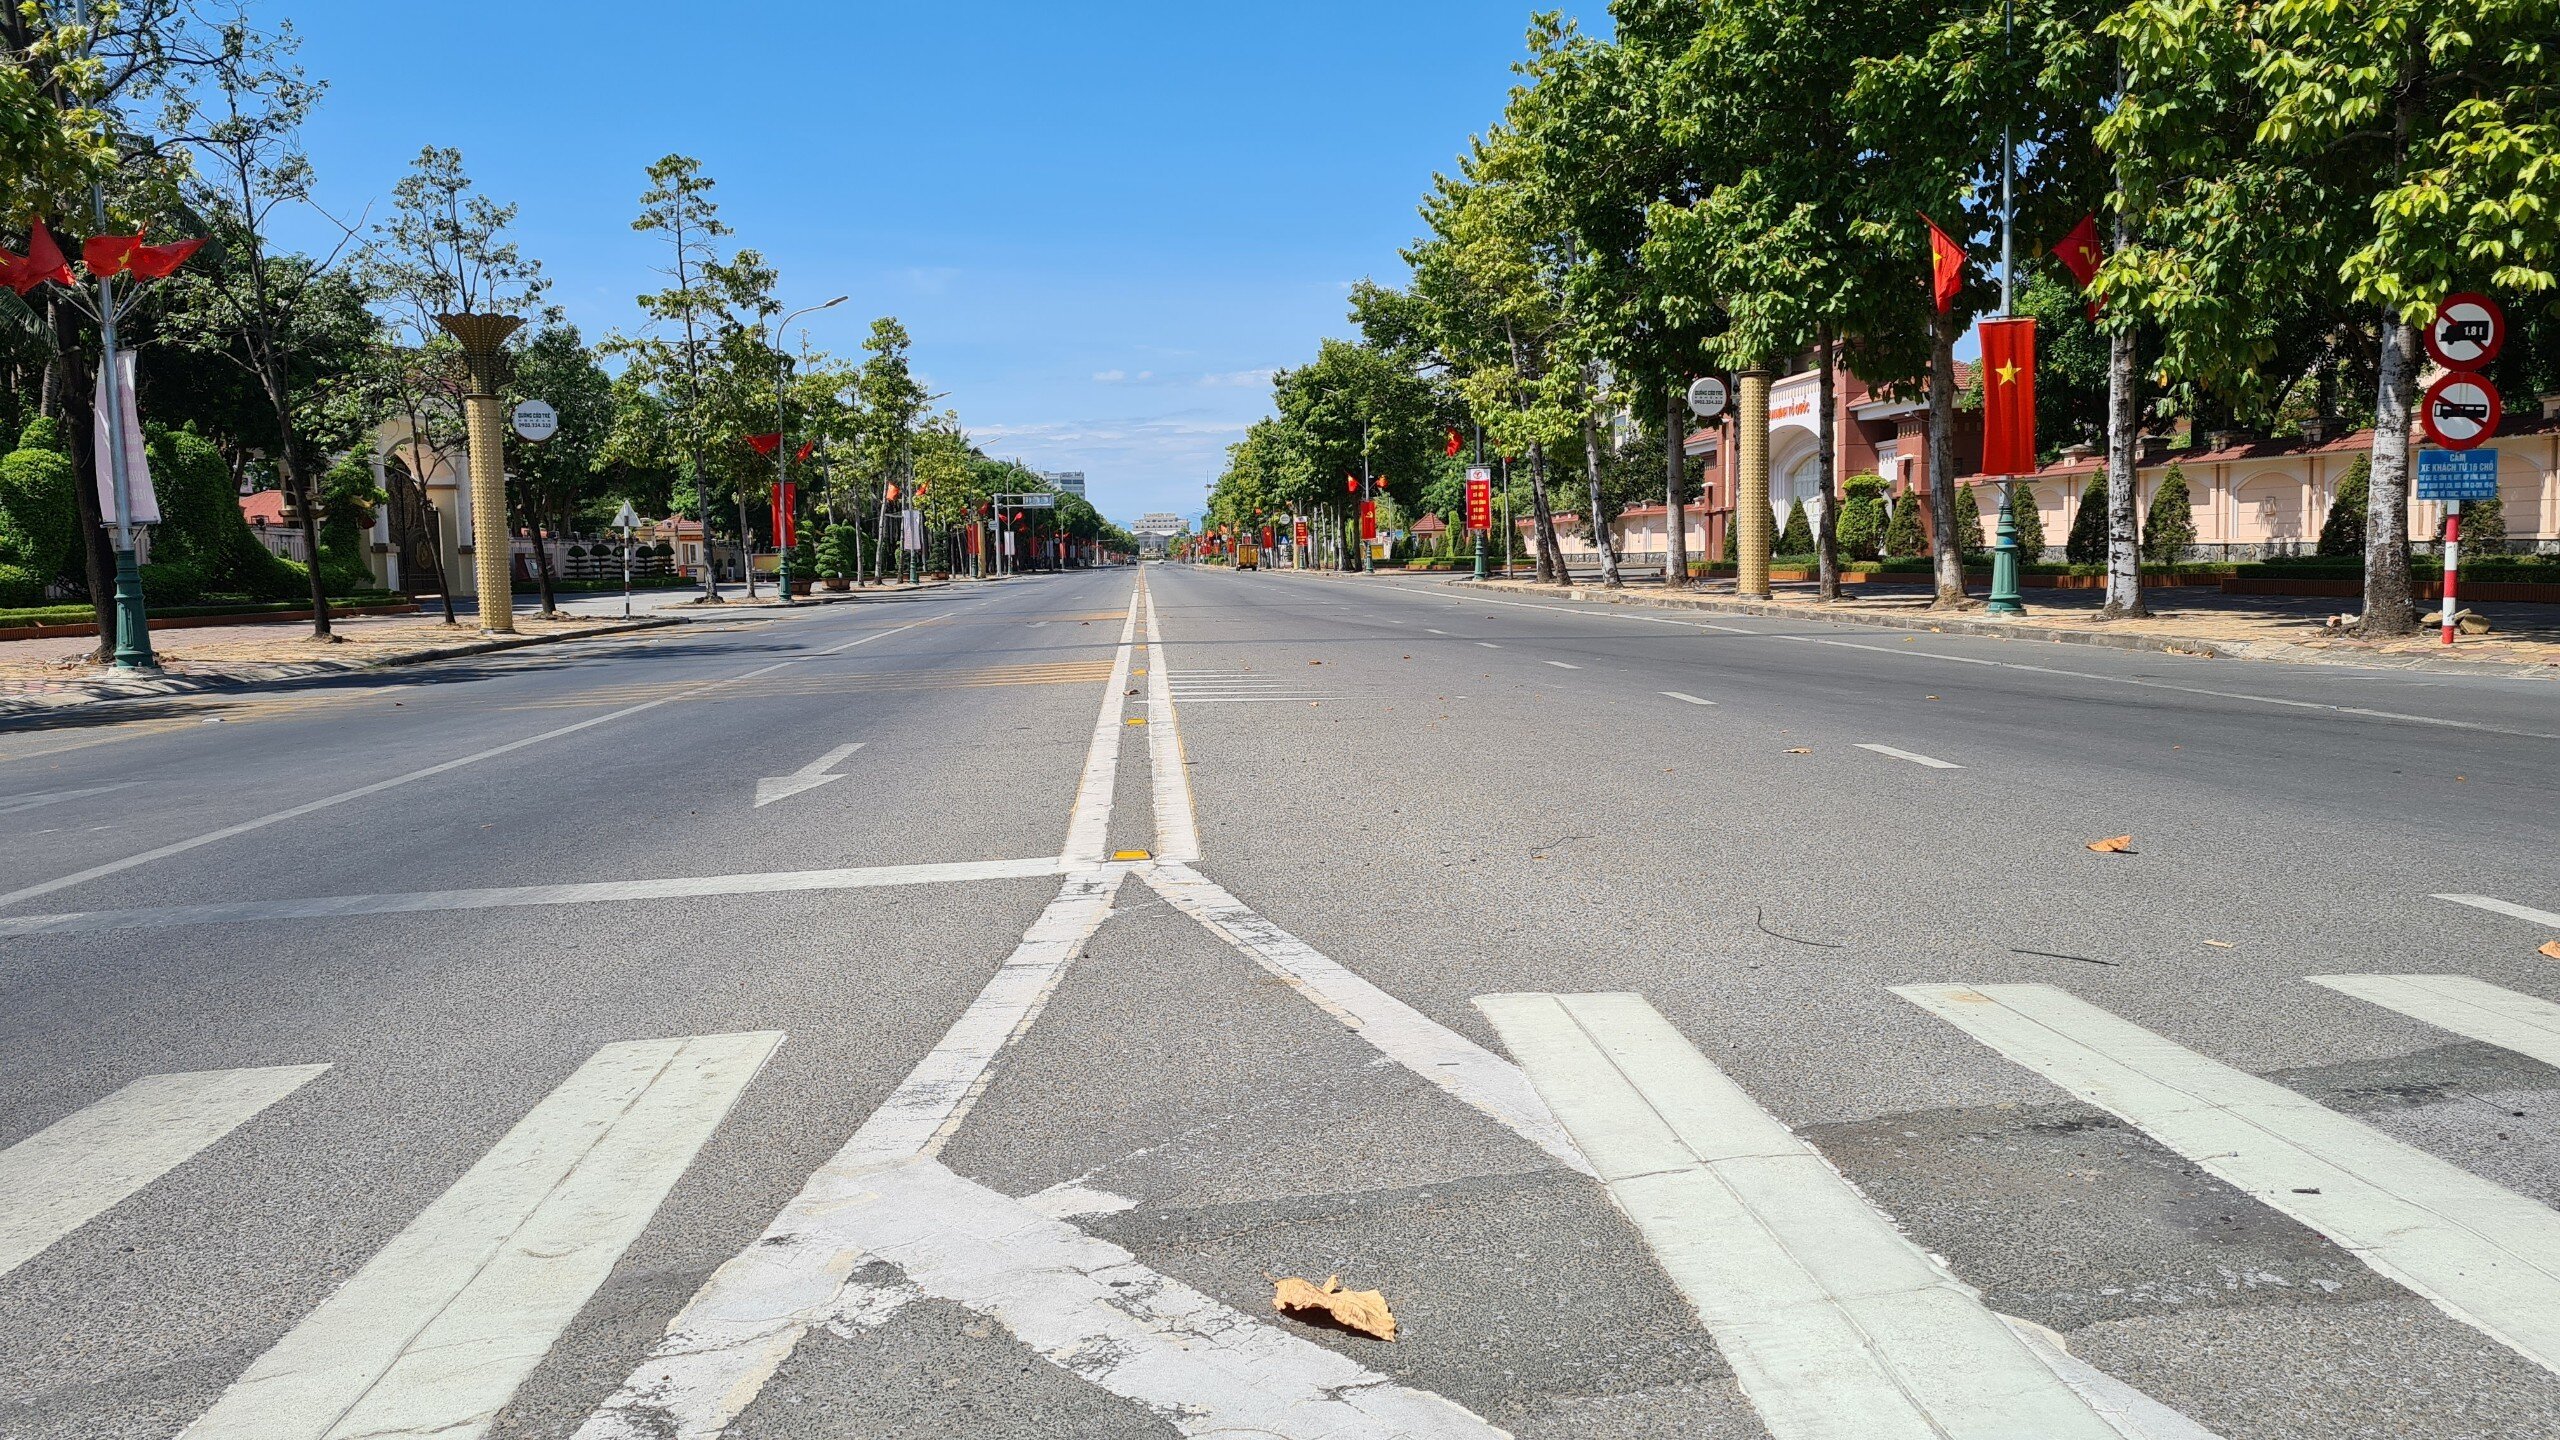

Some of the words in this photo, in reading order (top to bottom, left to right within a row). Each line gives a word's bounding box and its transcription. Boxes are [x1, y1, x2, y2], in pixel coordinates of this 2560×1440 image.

[2464, 326, 2477, 336] 1,8
[2450, 451, 2466, 462] CẤM
[2420, 463, 2430, 472] XE
[2432, 462, 2456, 471] KHÁCH
[2459, 462, 2468, 471] TỪ
[2469, 463, 2477, 471] 16
